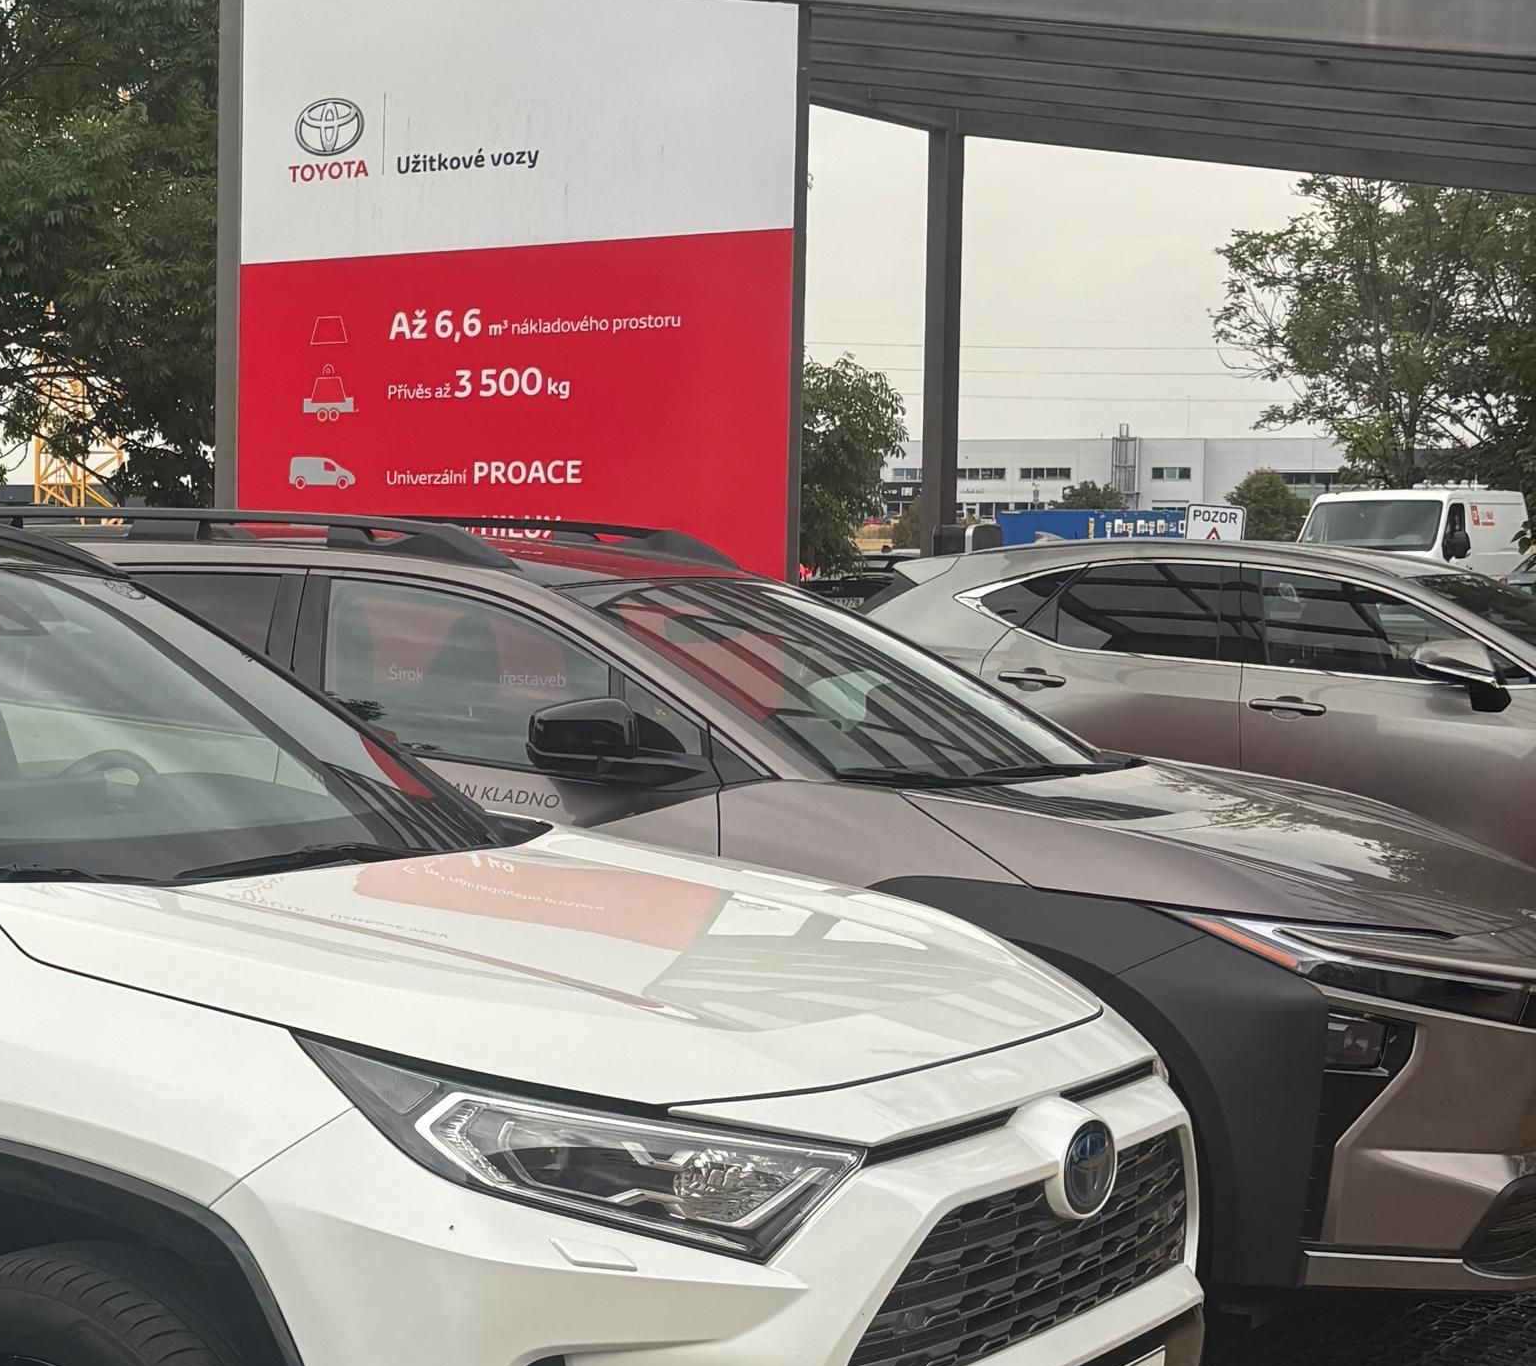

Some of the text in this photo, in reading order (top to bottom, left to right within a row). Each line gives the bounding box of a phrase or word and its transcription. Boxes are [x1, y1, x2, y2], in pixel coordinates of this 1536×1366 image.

[288, 160, 369, 183] TOYOTA
[396, 147, 540, 175] Užitkové vozy
[388, 308, 428, 341] Až
[434, 308, 482, 343] 6,6
[511, 315, 609, 335] nákladového
[612, 314, 682, 334] prostoru
[387, 384, 432, 400] Přívěs
[435, 382, 451, 399] až
[546, 377, 571, 400] kg
[386, 459, 583, 486] Univerzální PROACE
[1192, 509, 1239, 525] POZOR
[388, 663, 425, 682] Širok
[480, 785, 561, 809] KLADNO
